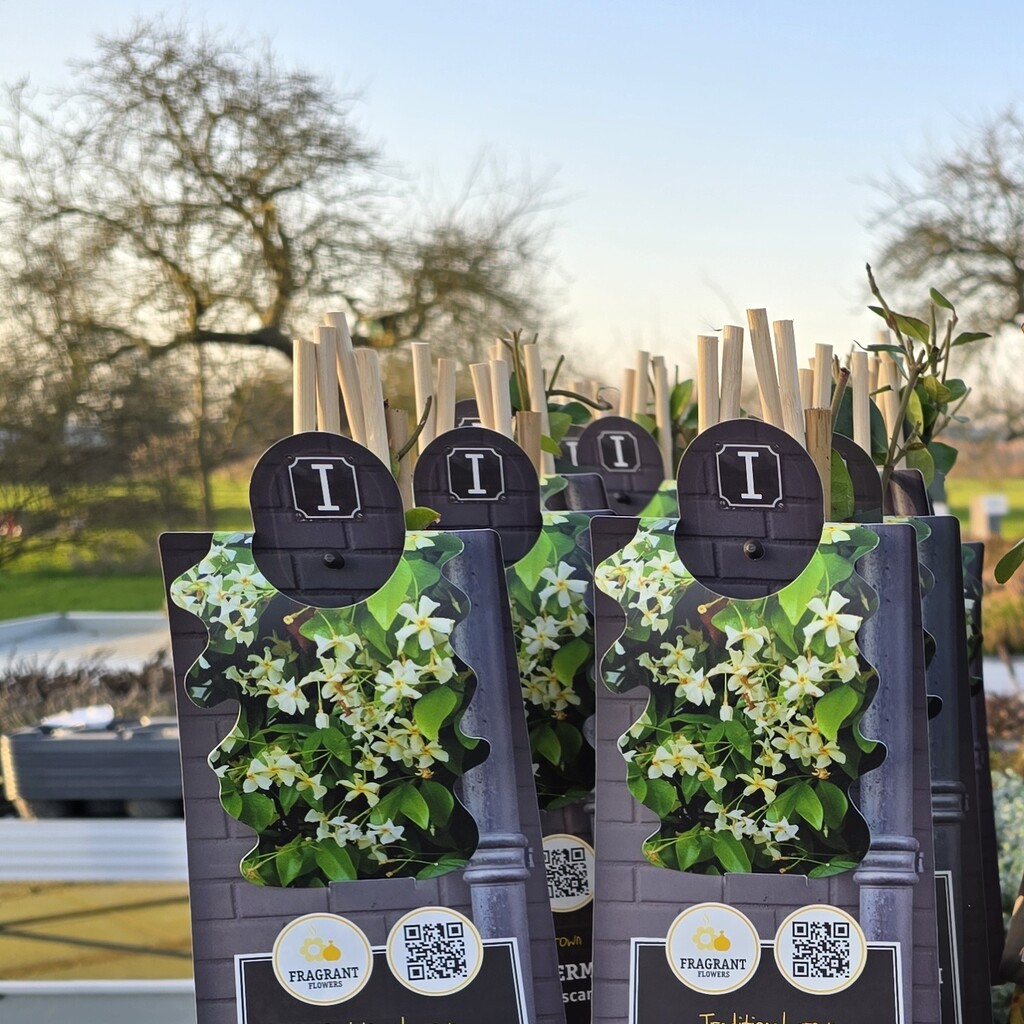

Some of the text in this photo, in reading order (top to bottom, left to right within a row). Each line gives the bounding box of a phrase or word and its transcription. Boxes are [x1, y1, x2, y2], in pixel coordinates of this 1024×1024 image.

[464, 453, 487, 494] I
[738, 451, 762, 499] I
[310, 463, 341, 511] I
[680, 958, 747, 970] FRAGRANT
[288, 966, 360, 983] FRAGRANT
[698, 970, 731, 978] FLOWERS
[308, 981, 343, 990] FLOWERS
